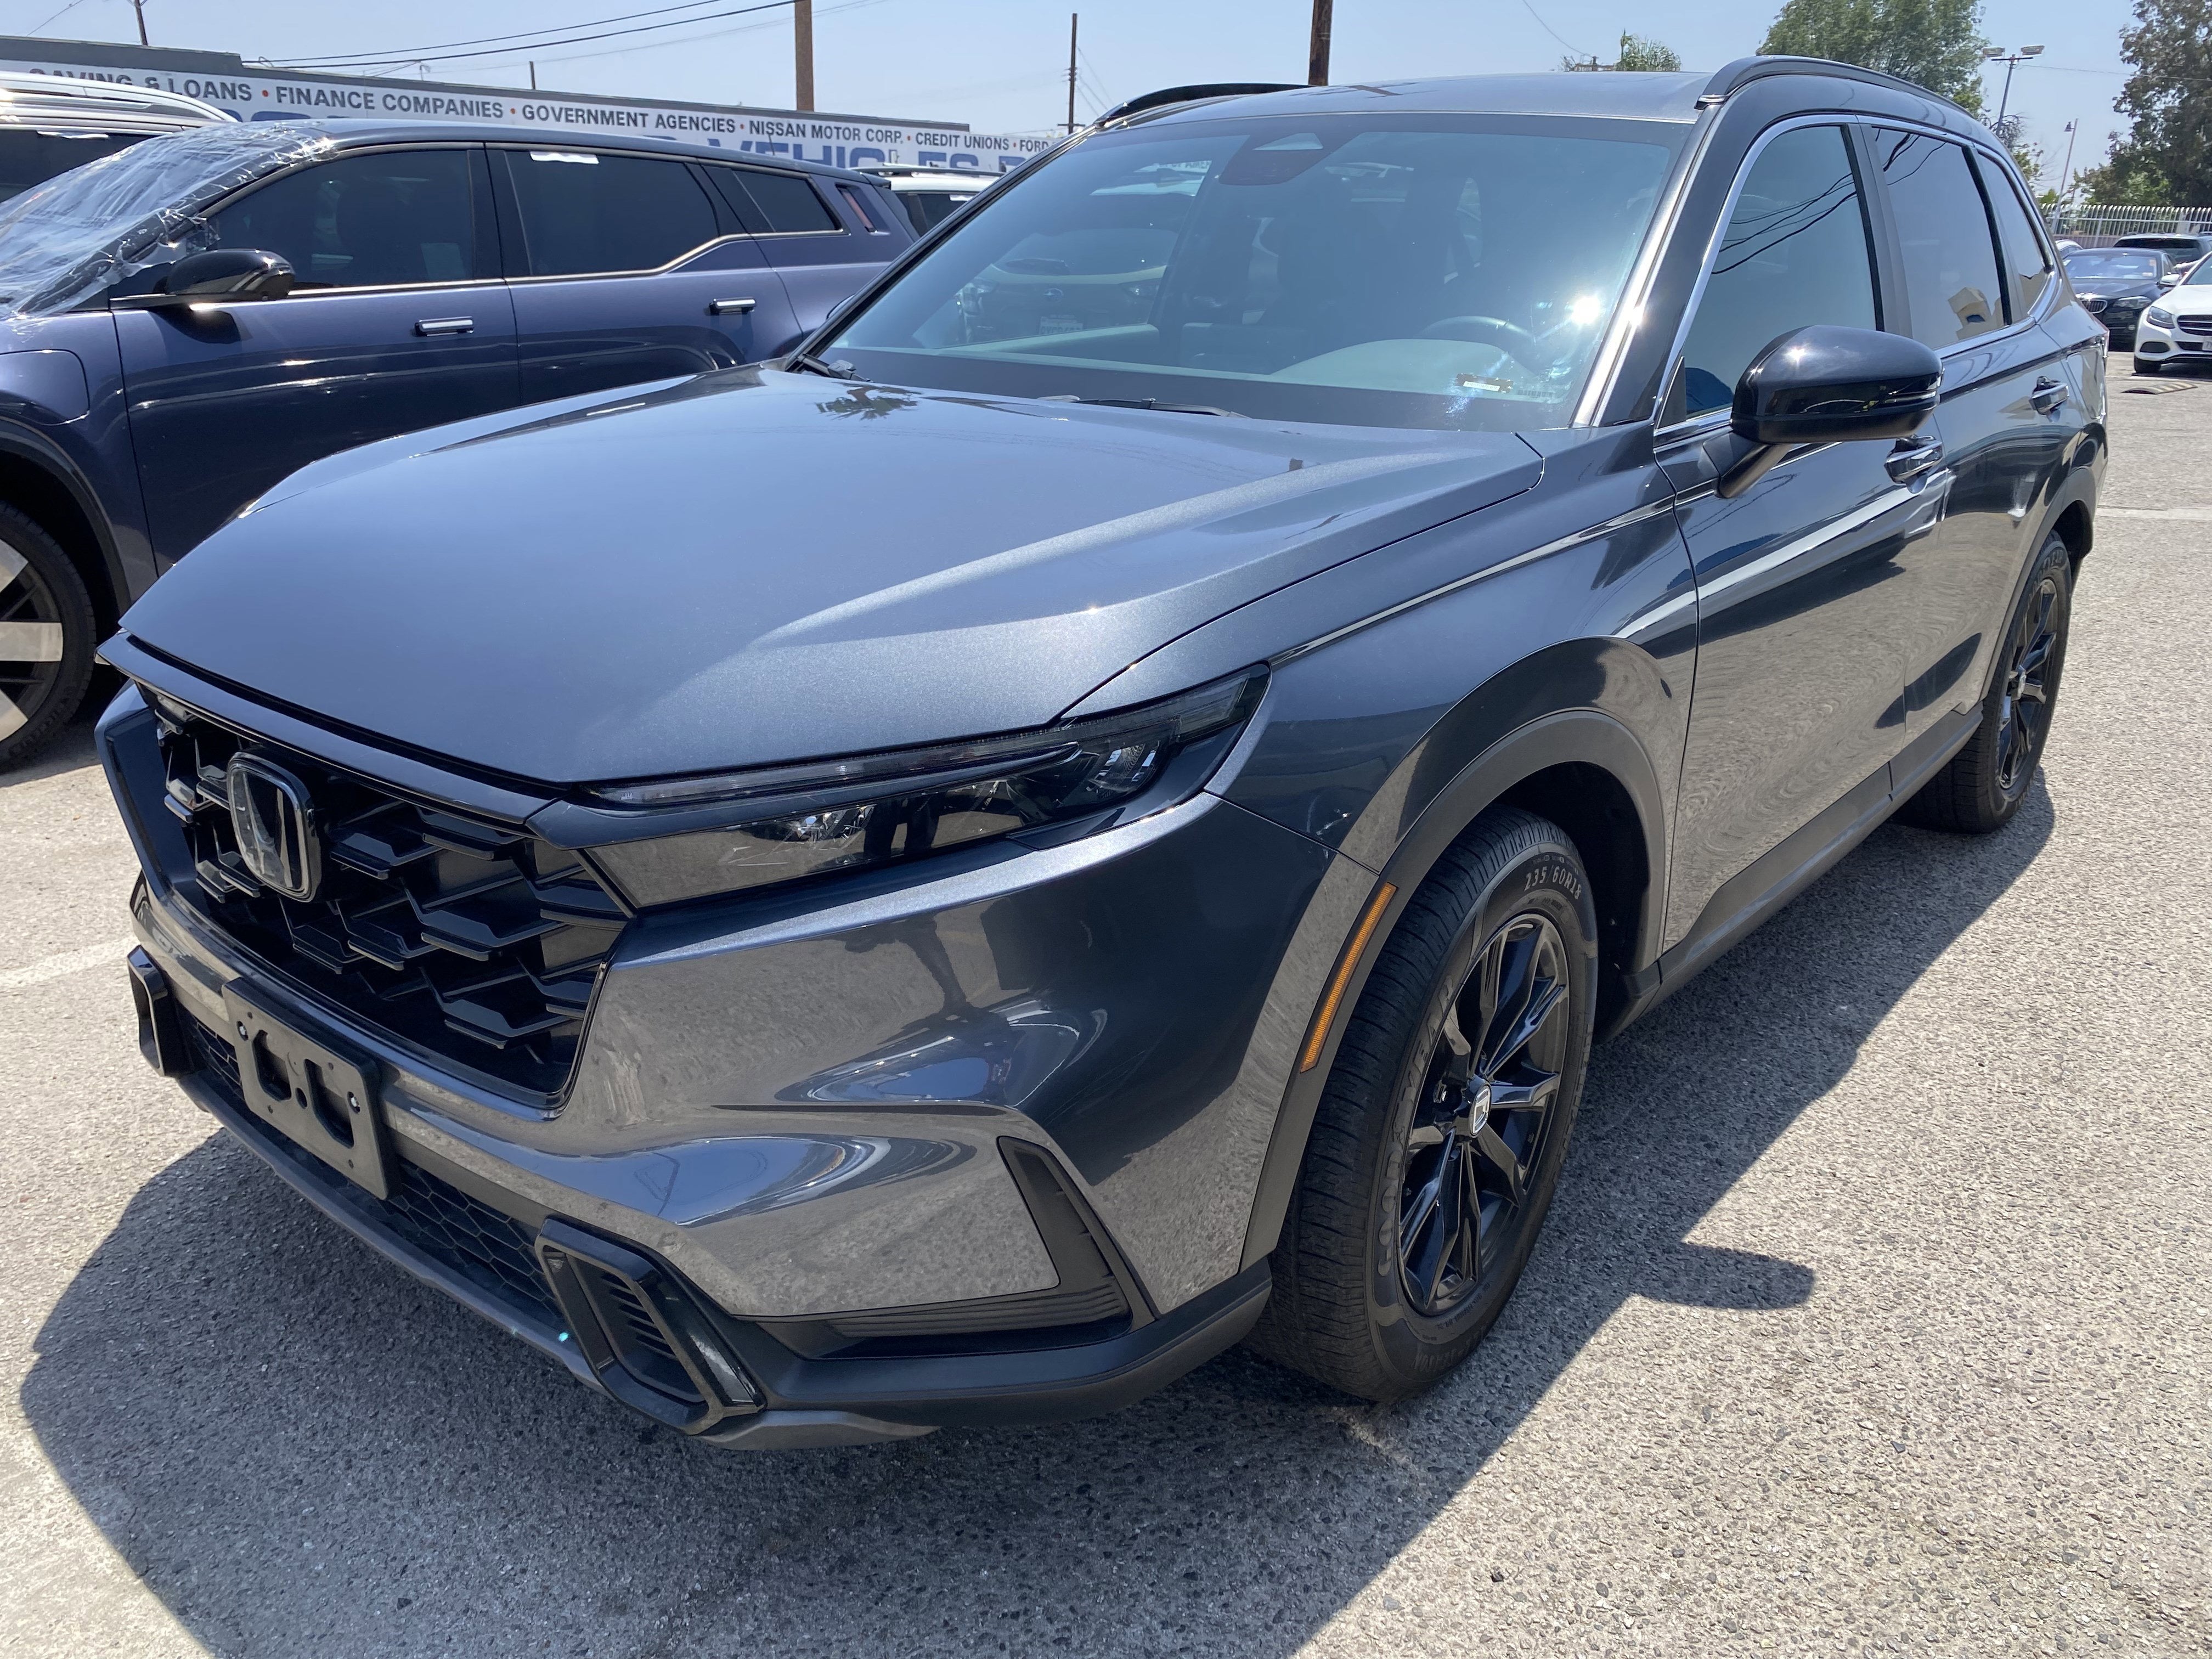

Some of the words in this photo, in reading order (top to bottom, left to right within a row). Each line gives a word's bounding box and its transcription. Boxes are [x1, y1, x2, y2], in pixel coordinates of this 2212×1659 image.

[167, 78, 253, 101] LOANS
[275, 86, 376, 110] FINANCE
[381, 93, 504, 119] COMPANIES
[521, 104, 650, 128] GOVERNMENT
[654, 114, 736, 134] AGENCIES
[749, 120, 806, 138] NISSAN
[810, 124, 861, 142] MOTOR
[865, 128, 904, 144] CORP.
[915, 132, 961, 148] CREDIT
[963, 135, 1009, 151] UNIONS
[1019, 139, 1049, 152] FORD
[1523, 864, 1582, 900] 235/60R18
